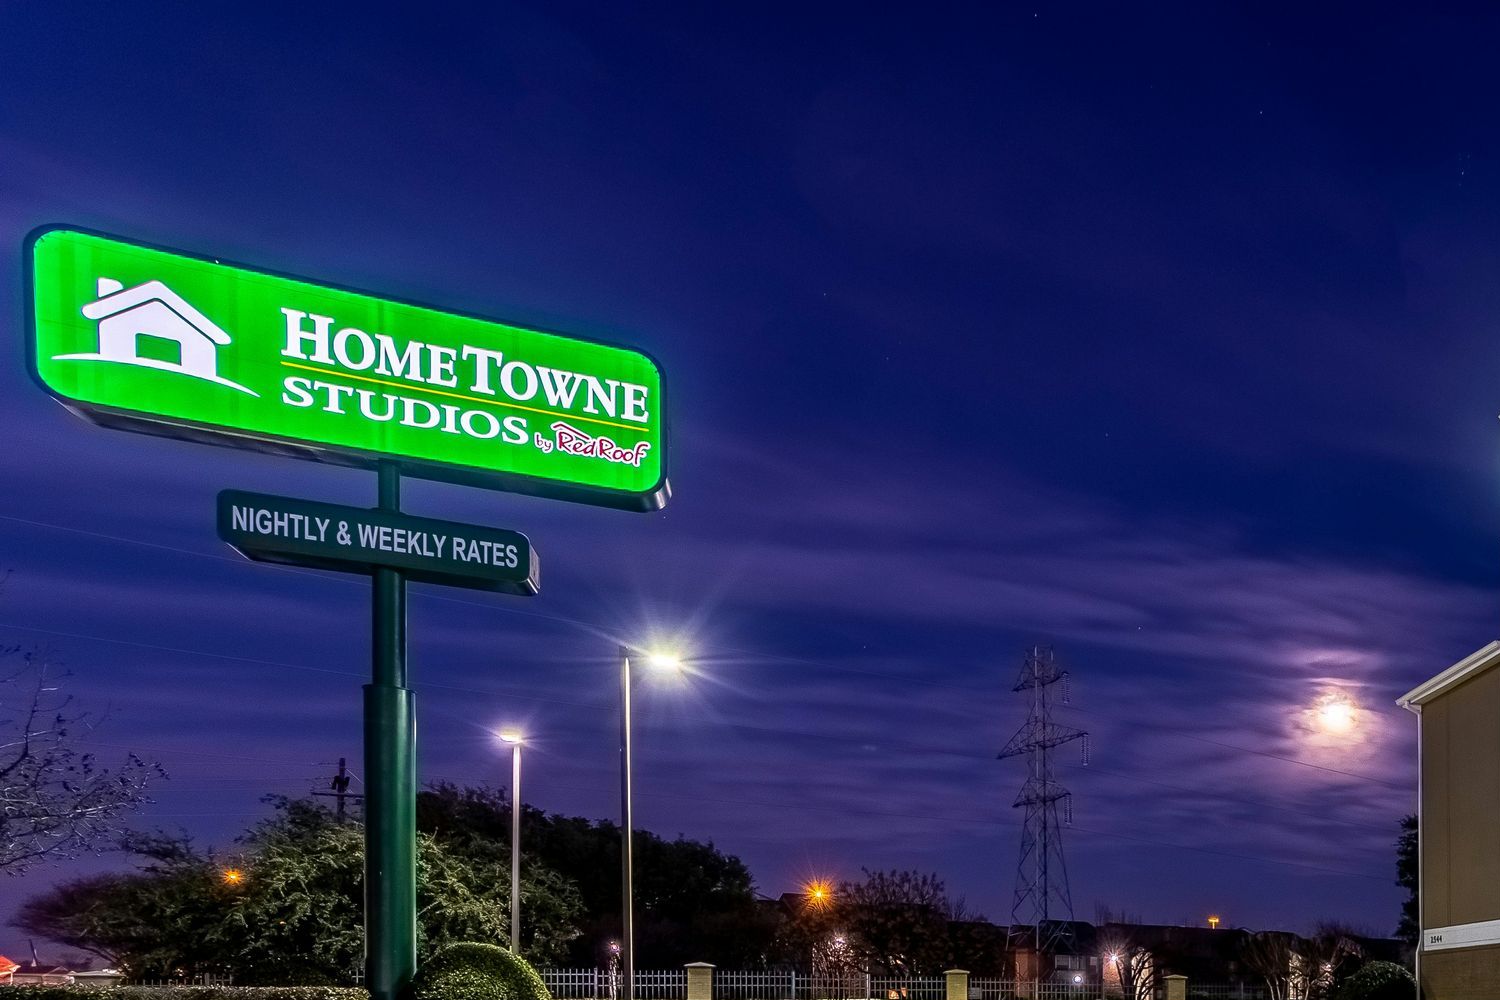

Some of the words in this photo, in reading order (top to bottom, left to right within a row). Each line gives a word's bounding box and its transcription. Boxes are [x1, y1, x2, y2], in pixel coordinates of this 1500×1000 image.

[282, 376, 529, 445] STUDIOS
[534, 432, 553, 453] by
[232, 505, 330, 543] NIGHTLY
[336, 520, 352, 546] &
[358, 523, 447, 558] WEEKLY
[453, 537, 518, 568] RATES
